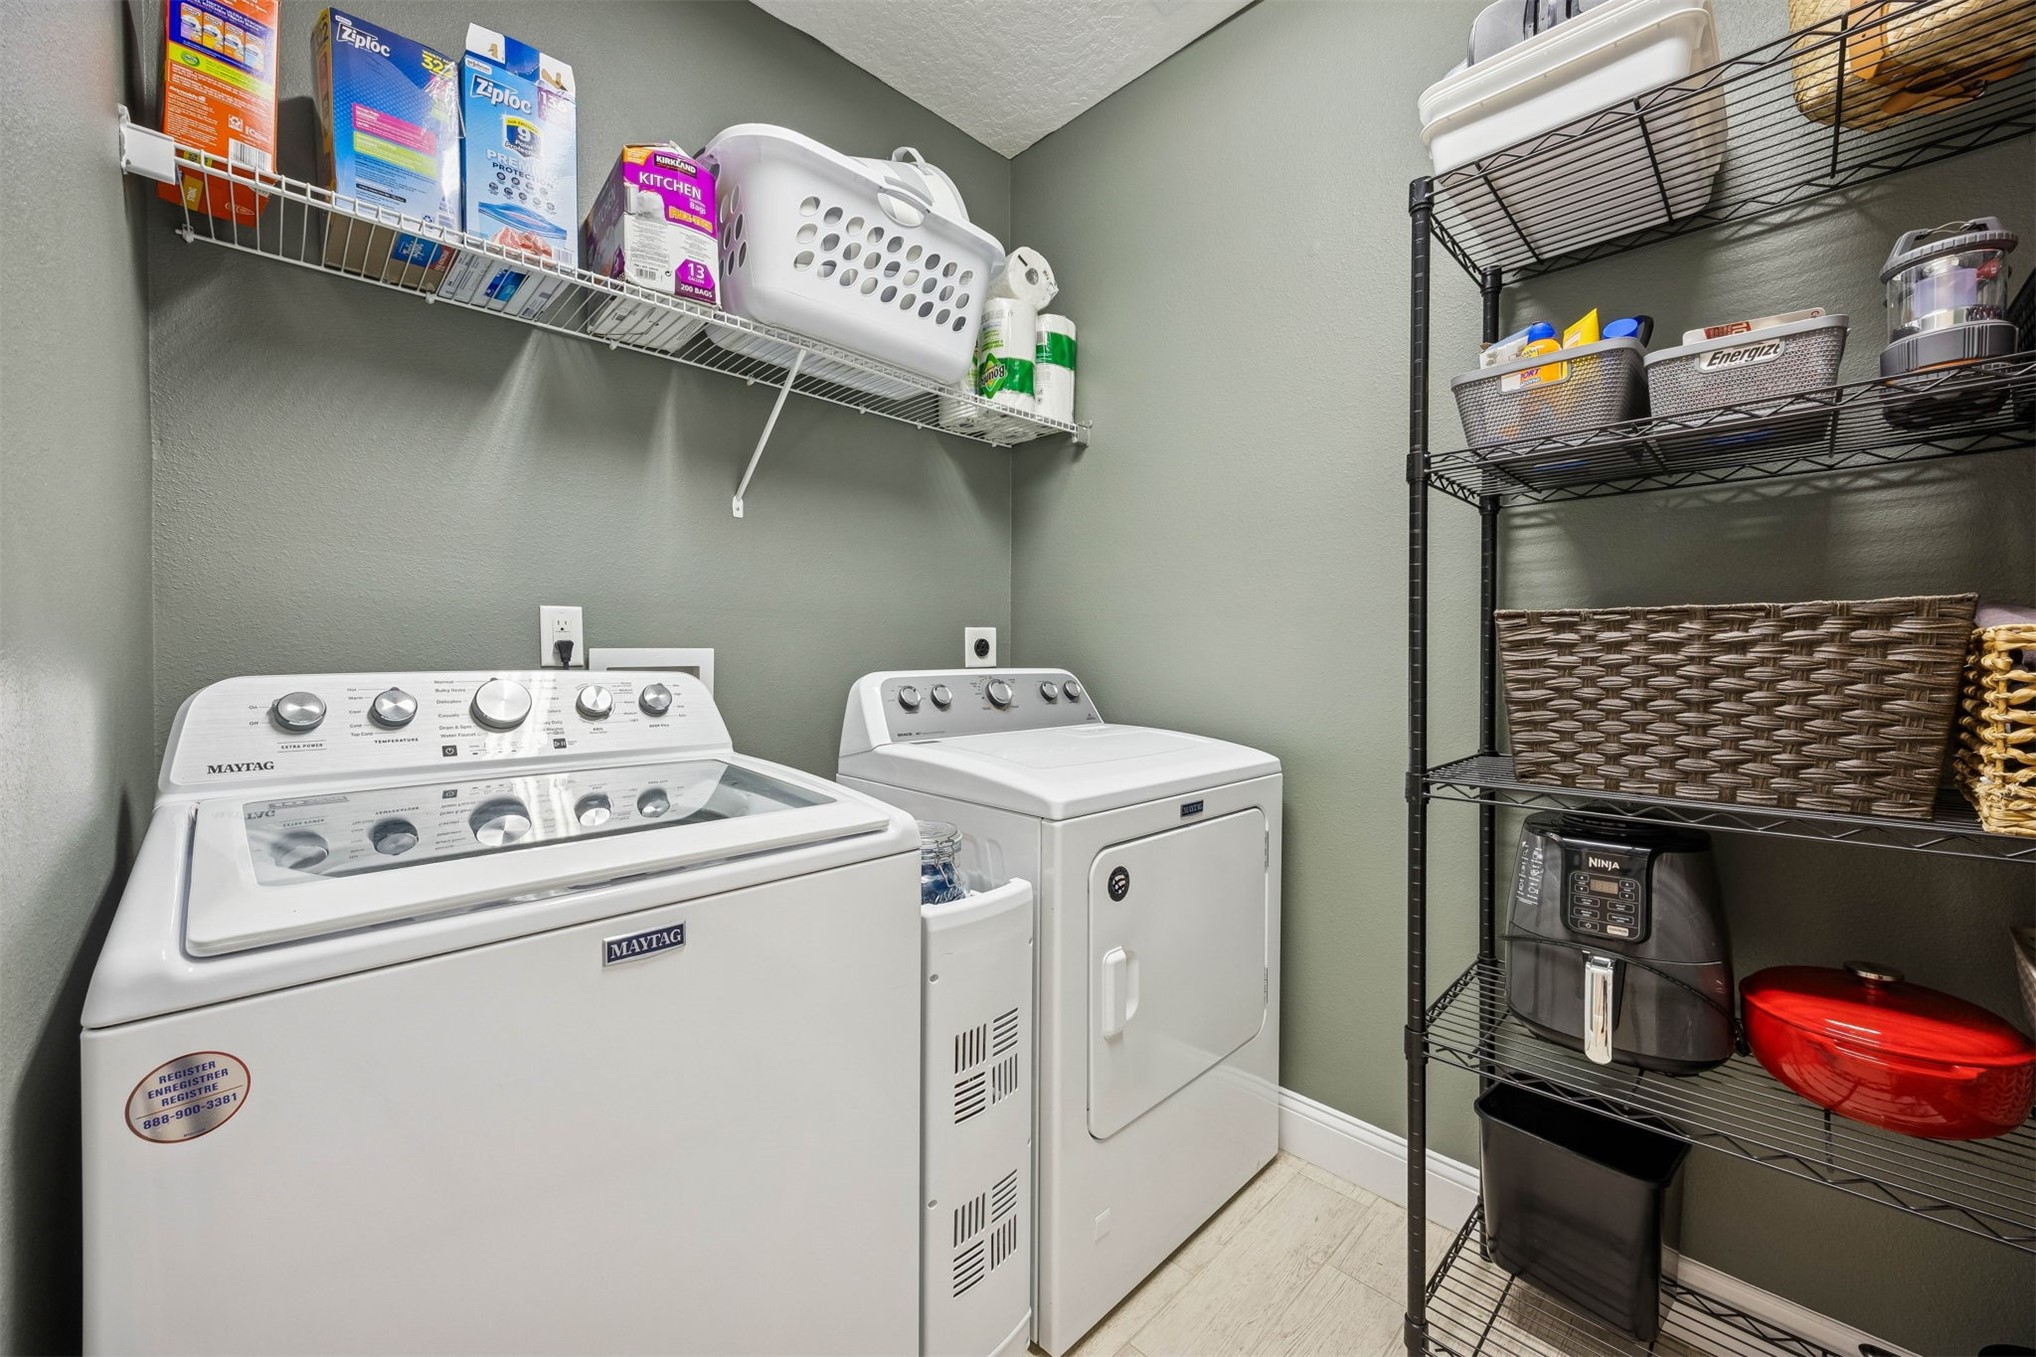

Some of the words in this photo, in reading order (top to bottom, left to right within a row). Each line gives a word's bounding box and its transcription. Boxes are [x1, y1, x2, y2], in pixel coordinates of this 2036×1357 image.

[341, 26, 391, 57] Ziploc
[476, 78, 532, 114] Ziploc
[517, 126, 531, 141] 9
[656, 155, 696, 174] KIRKLAND
[639, 172, 702, 200] KITCHEN
[688, 263, 705, 279] 13
[680, 284, 694, 293] 200
[694, 285, 713, 298] BAGS
[374, 737, 420, 745] TEMPERATURE
[206, 760, 275, 775] MAYTAG
[1588, 856, 1620, 872] NINJA
[610, 928, 682, 960] MAYTAG
[147, 1068, 229, 1100] ENREGISTRER
[158, 1060, 217, 1084] REGISTER
[161, 1082, 219, 1107] REGISTRE
[143, 1092, 238, 1130] 888-900-3381
